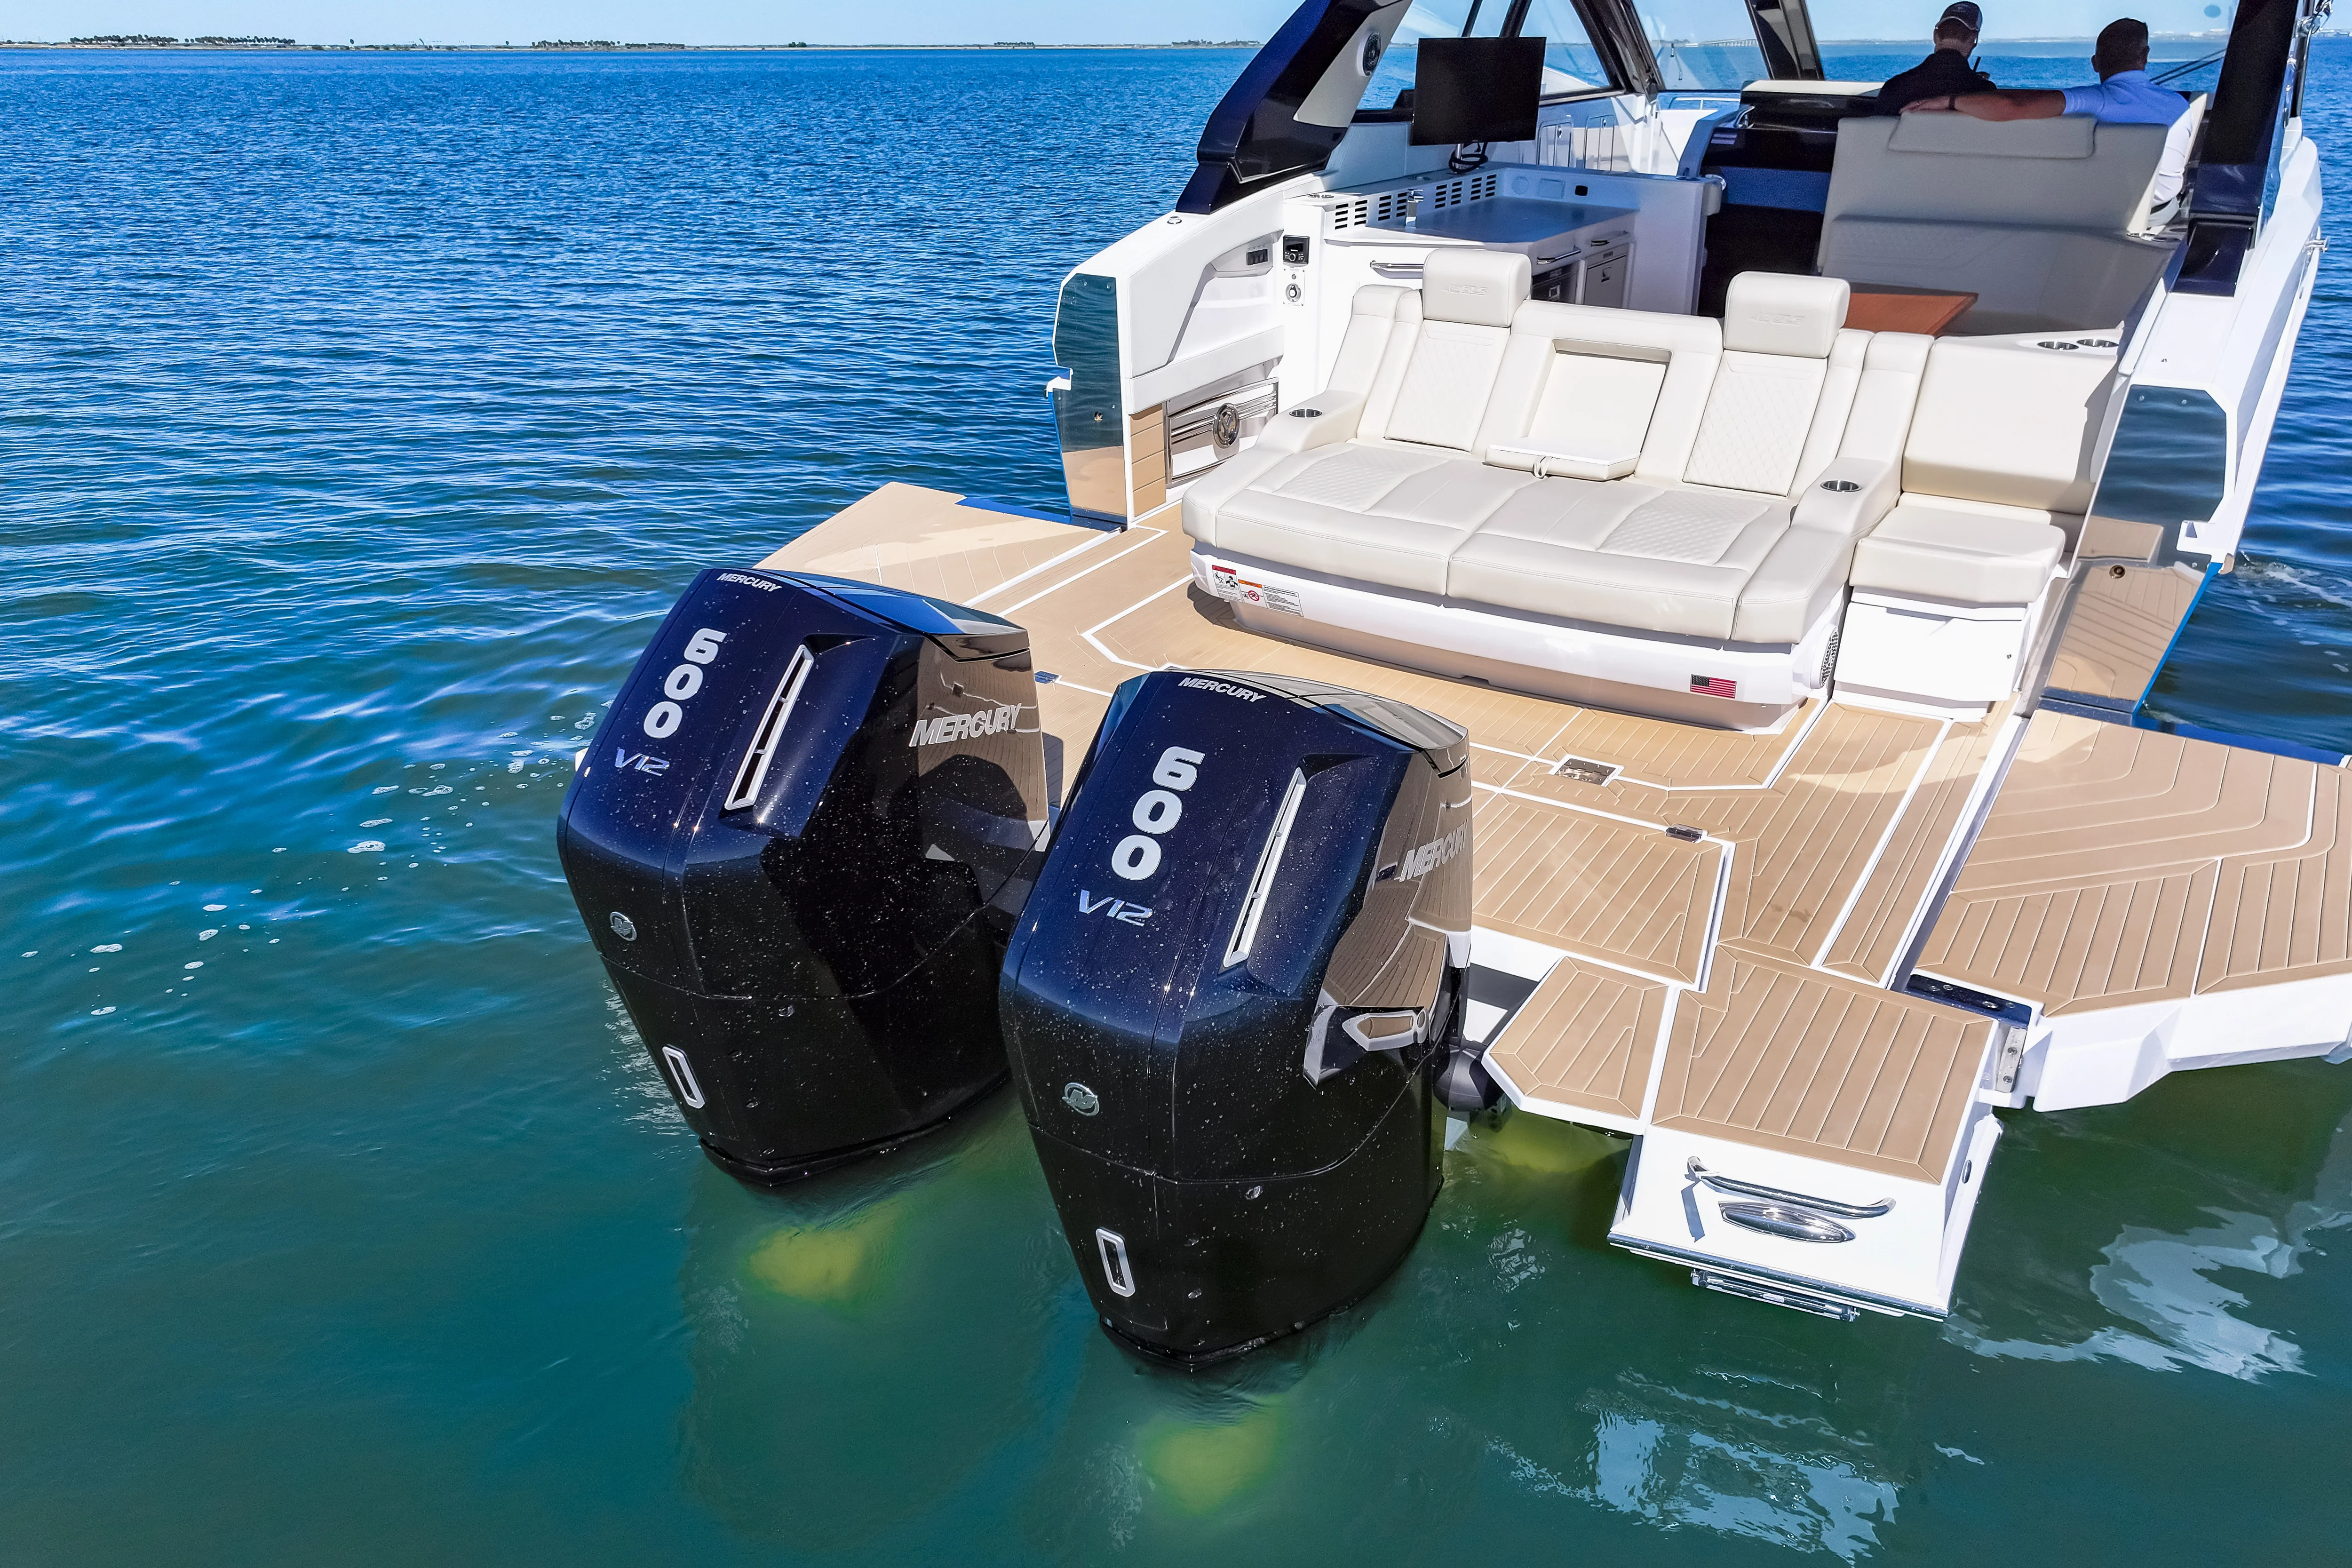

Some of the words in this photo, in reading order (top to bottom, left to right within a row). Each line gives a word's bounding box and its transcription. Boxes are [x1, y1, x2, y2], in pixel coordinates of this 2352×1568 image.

[716, 573, 782, 592] MERCURY
[644, 628, 727, 739] 600
[1178, 677, 1267, 702] MERCURY
[908, 703, 1022, 747] MERCURY
[615, 748, 670, 776] V12
[1112, 746, 1205, 880] 600
[1399, 818, 1468, 882] MERCURY
[1079, 889, 1152, 926] V12
